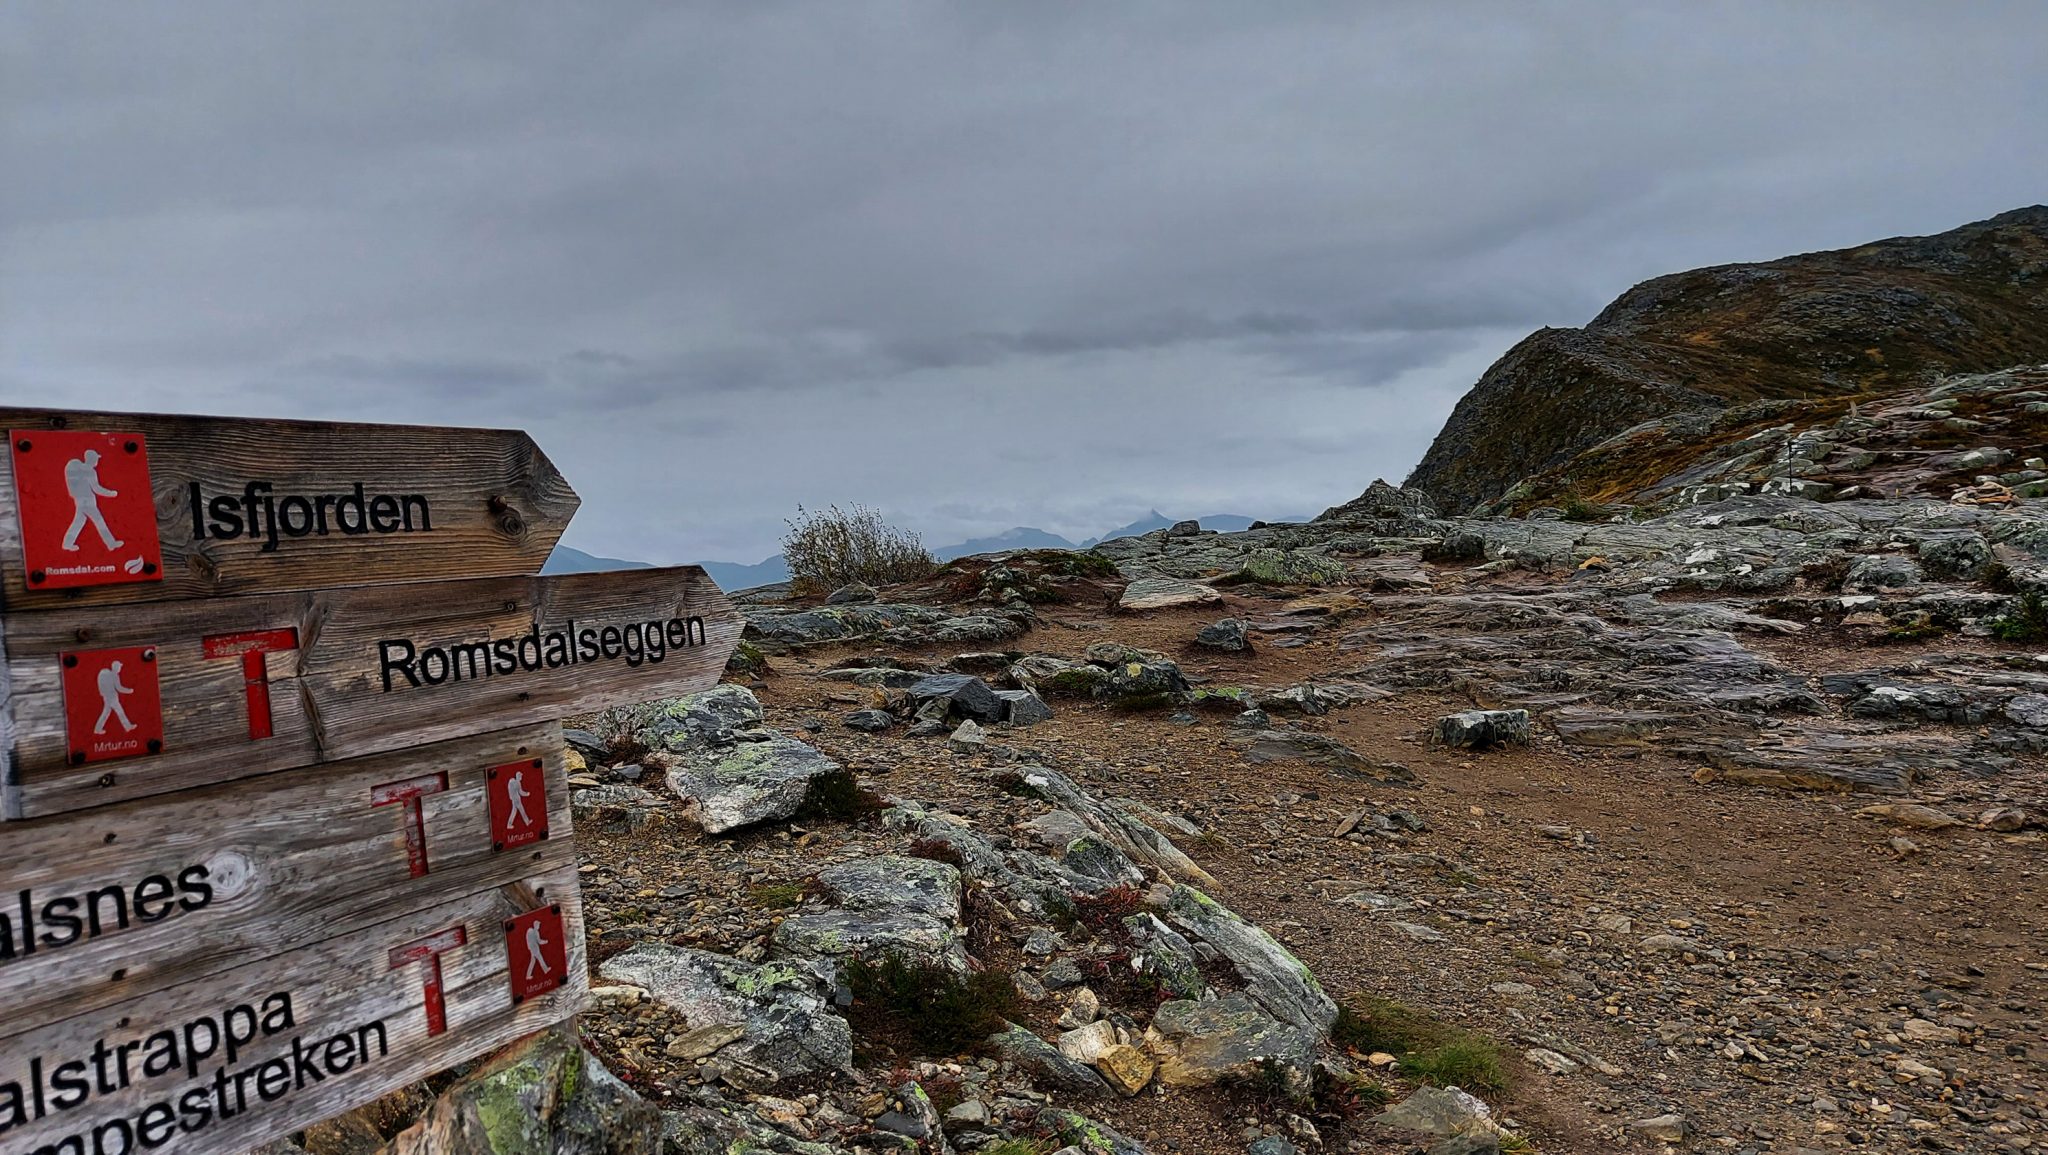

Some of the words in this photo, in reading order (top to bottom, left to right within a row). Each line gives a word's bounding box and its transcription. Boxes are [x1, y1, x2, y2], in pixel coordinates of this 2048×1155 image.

[190, 481, 432, 551] Isfjorden
[45, 565, 116, 576] Romsdal.com
[203, 627, 299, 739] T
[378, 615, 706, 692] Romsdalseggen
[94, 740, 138, 752] Mrtur.no
[370, 770, 450, 879] T
[507, 831, 534, 843] Mrtur.no
[388, 924, 468, 1037] T
